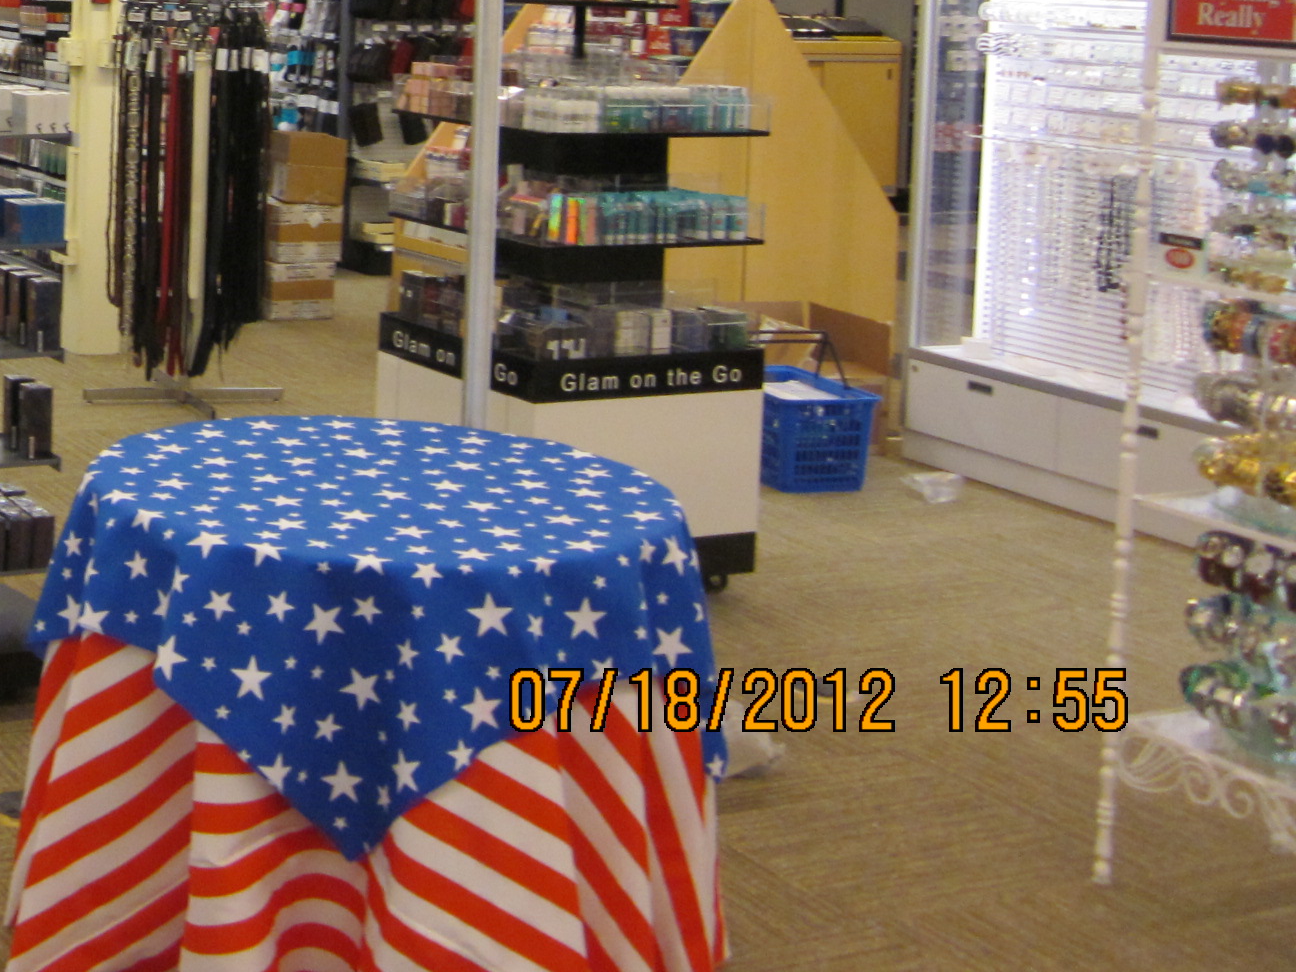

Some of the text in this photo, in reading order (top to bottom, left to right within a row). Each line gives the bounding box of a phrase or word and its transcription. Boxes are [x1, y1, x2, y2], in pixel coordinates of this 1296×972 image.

[1196, 2, 1266, 36] Really
[392, 330, 519, 386] Glam on Go
[560, 365, 743, 393] Glam on the Go
